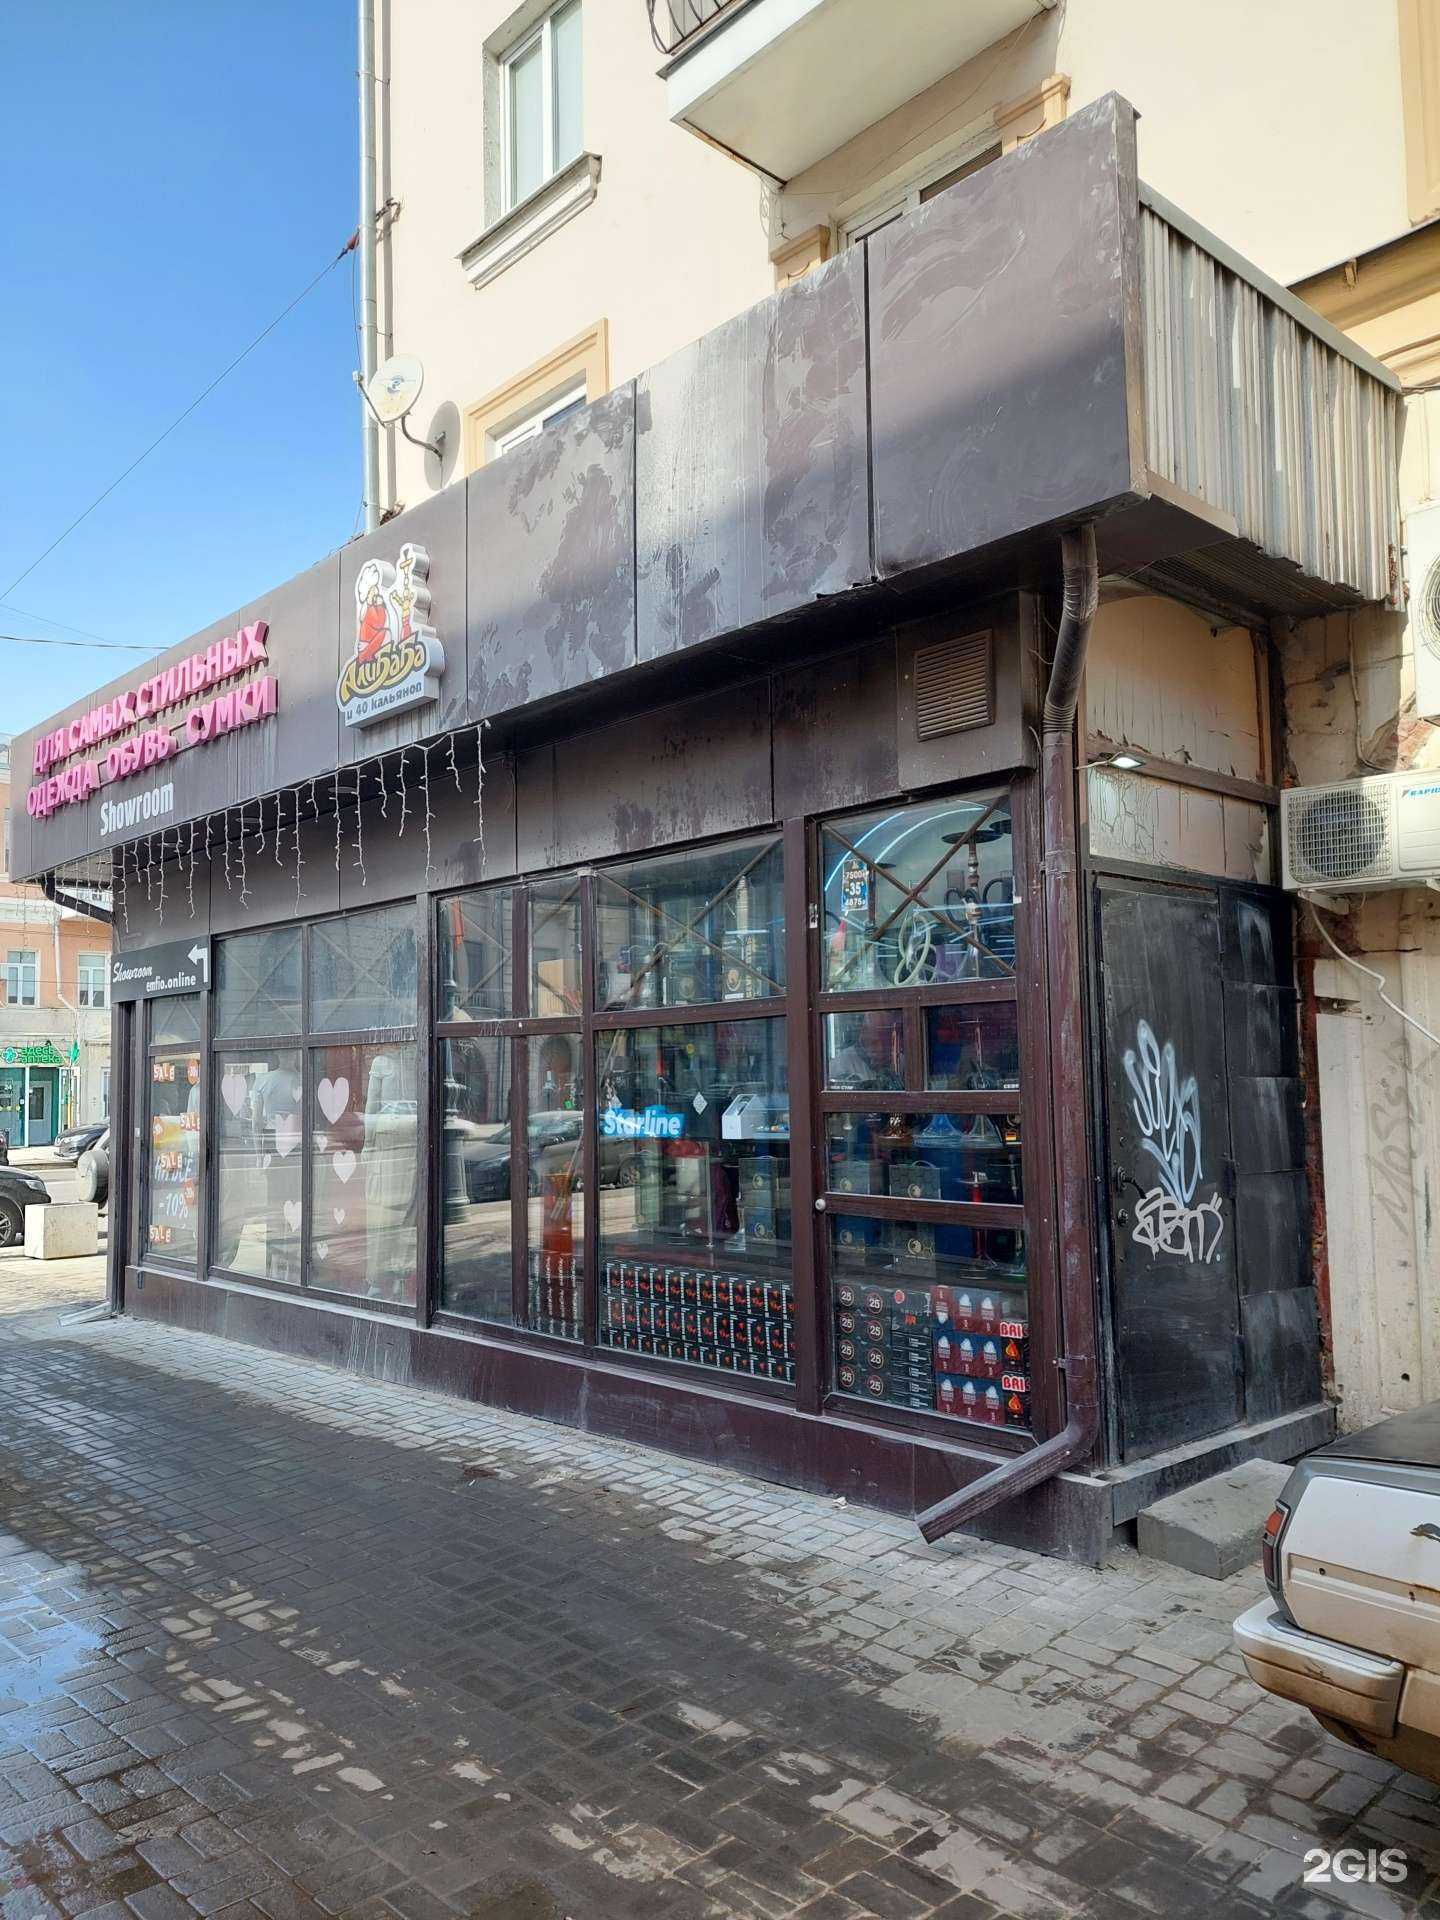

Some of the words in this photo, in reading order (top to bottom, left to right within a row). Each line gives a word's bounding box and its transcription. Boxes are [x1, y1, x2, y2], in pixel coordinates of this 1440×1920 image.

[33, 727, 69, 775] ДЛЯ
[68, 691, 136, 750] САМЫХ
[136, 620, 269, 718] СТИЛЬНЫХ
[356, 701, 368, 715] 40
[27, 760, 100, 818] ОДЕЖДА
[107, 725, 177, 781] ОБУВЬ
[186, 676, 278, 745] СУМКИ
[100, 782, 174, 836] Showroom
[112, 962, 153, 983] Showroom
[146, 971, 197, 992] emfio.online
[154, 1063, 175, 1081] SALE
[604, 1109, 681, 1138] Starline
[161, 1152, 183, 1169] SALE
[160, 1193, 189, 1218] -10%
[149, 1225, 171, 1243] SALE
[841, 1291, 852, 1301] 25
[870, 1298, 881, 1309] 25
[842, 1317, 852, 1328] 25
[870, 1326, 881, 1336] 25
[841, 1345, 852, 1355] 25
[870, 1354, 881, 1364] 25
[842, 1372, 852, 1382] 25
[870, 1380, 881, 1391] 25
